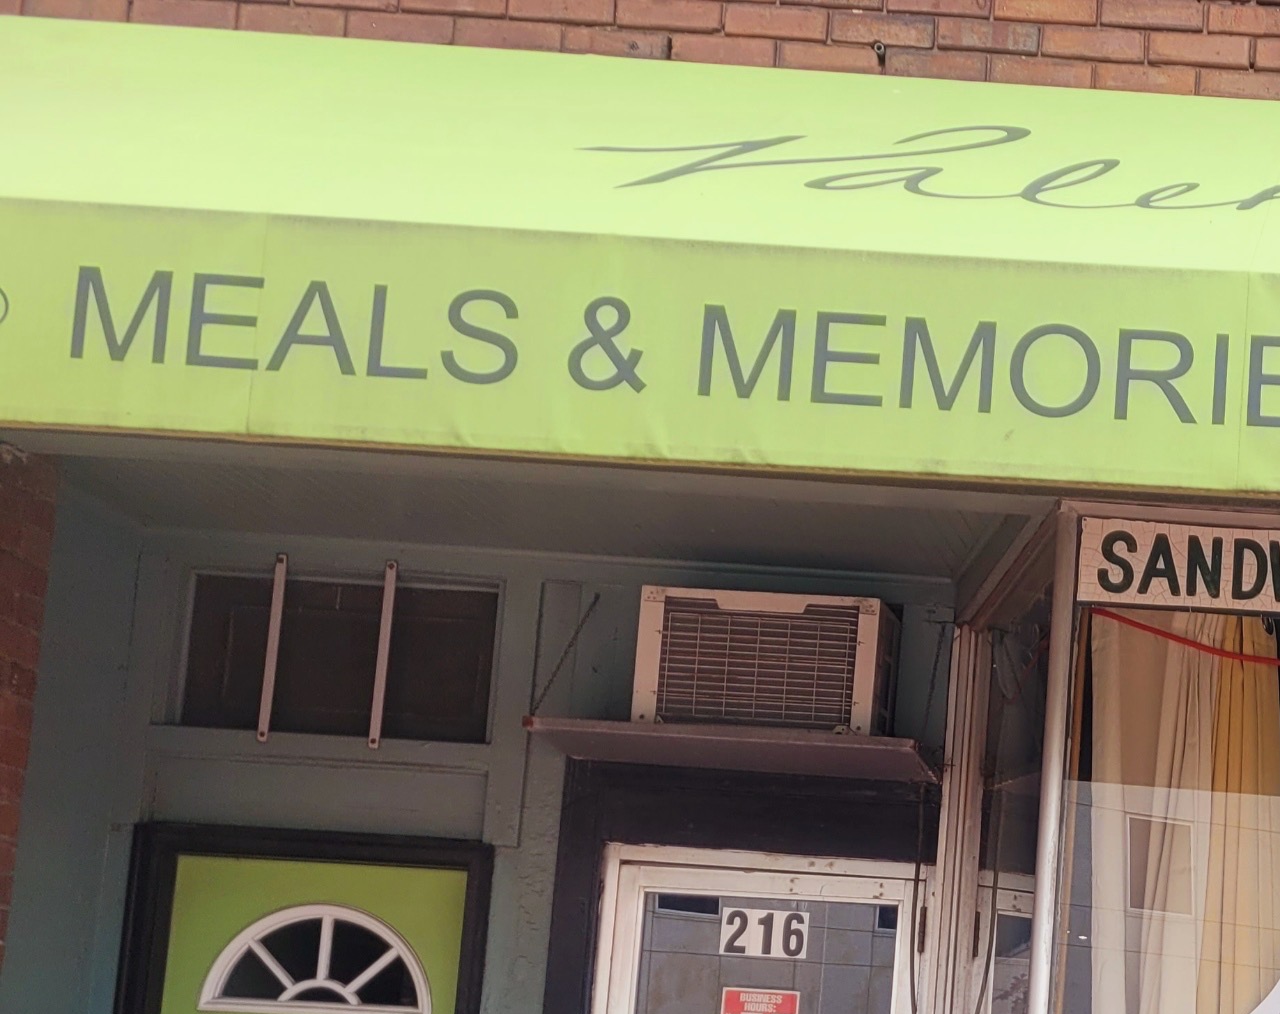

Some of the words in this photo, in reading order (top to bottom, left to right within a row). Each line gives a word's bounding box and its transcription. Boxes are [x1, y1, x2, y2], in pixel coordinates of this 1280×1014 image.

[69, 265, 519, 385] MEALS
[567, 295, 647, 394] &
[723, 909, 806, 957] 216
[740, 992, 783, 1004] BUSINESS
[744, 1002, 777, 1013] HOURS:
